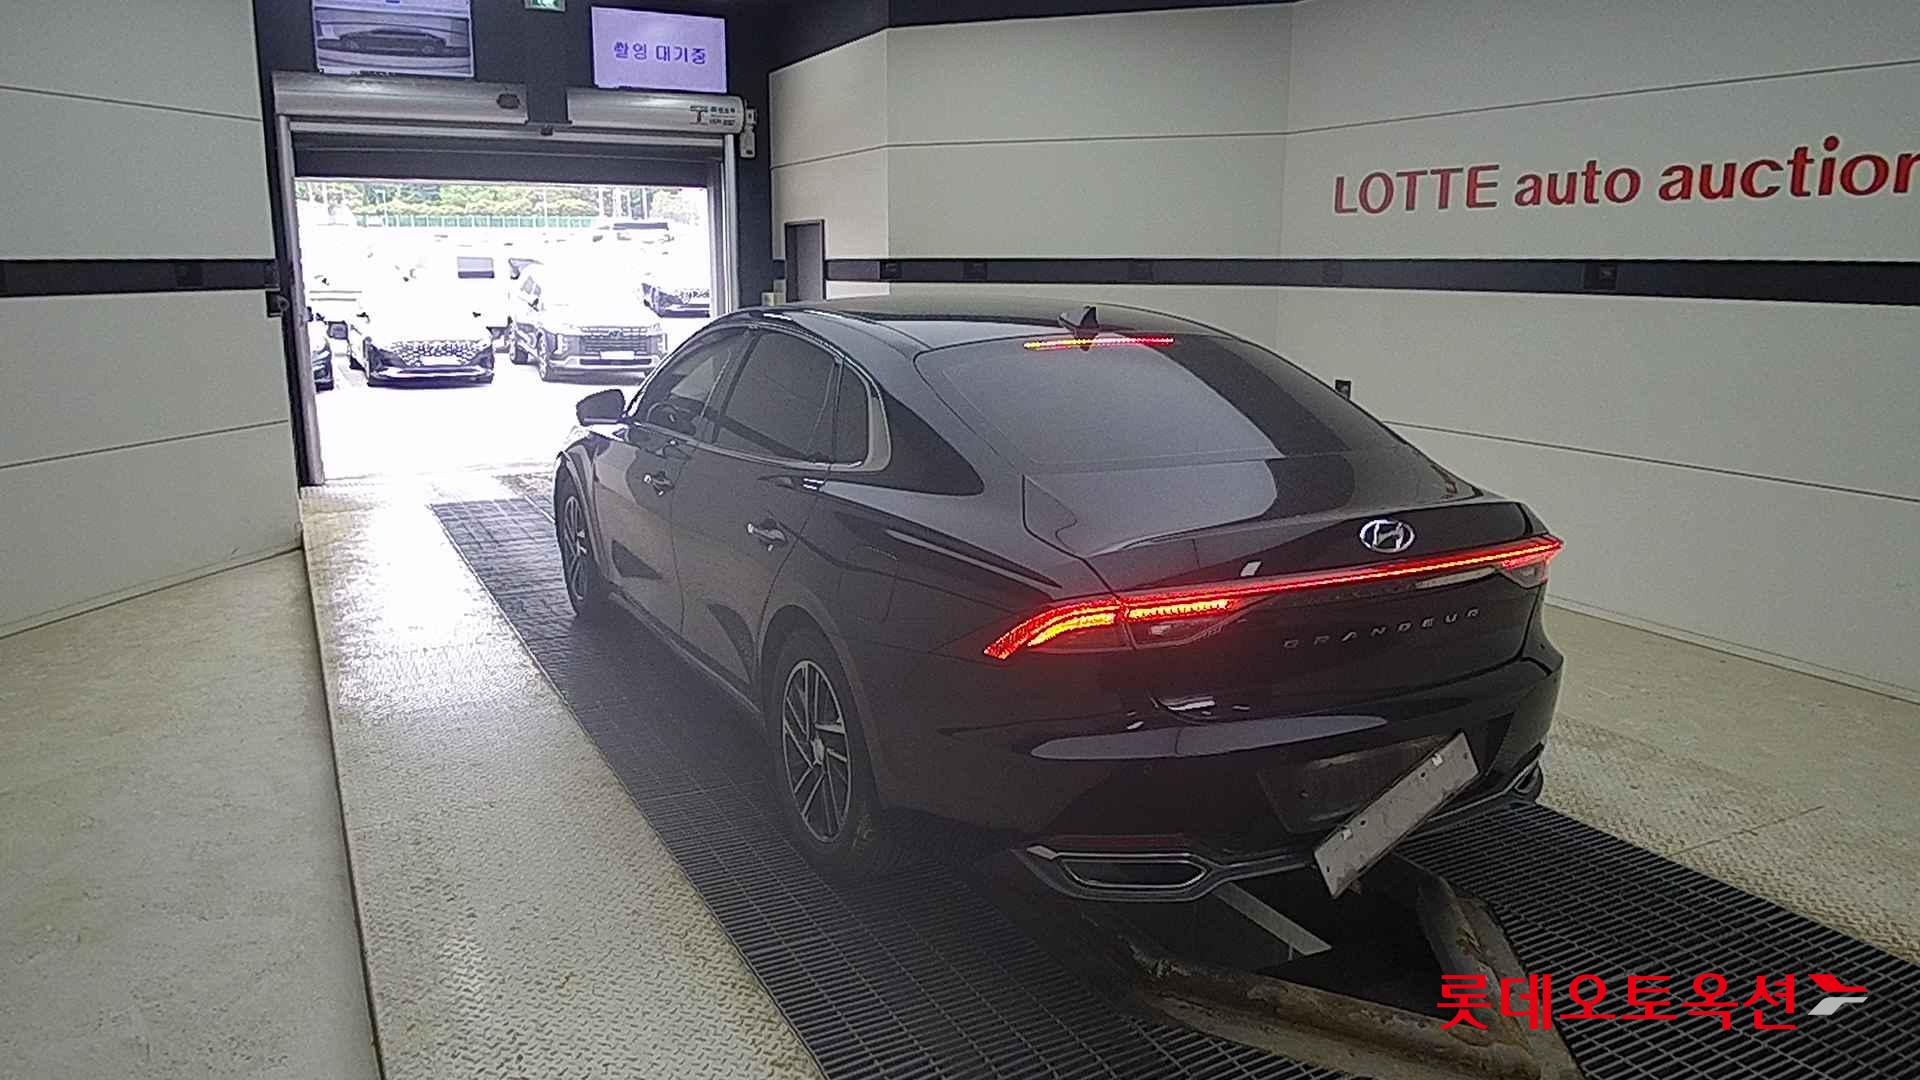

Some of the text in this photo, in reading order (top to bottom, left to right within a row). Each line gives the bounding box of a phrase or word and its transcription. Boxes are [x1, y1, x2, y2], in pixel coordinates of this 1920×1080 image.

[655, 45, 706, 64] 대기중
[1334, 164, 1499, 213] LOTTE
[1515, 160, 1640, 205] auto
[1282, 607, 1480, 649] GRANDEUR
